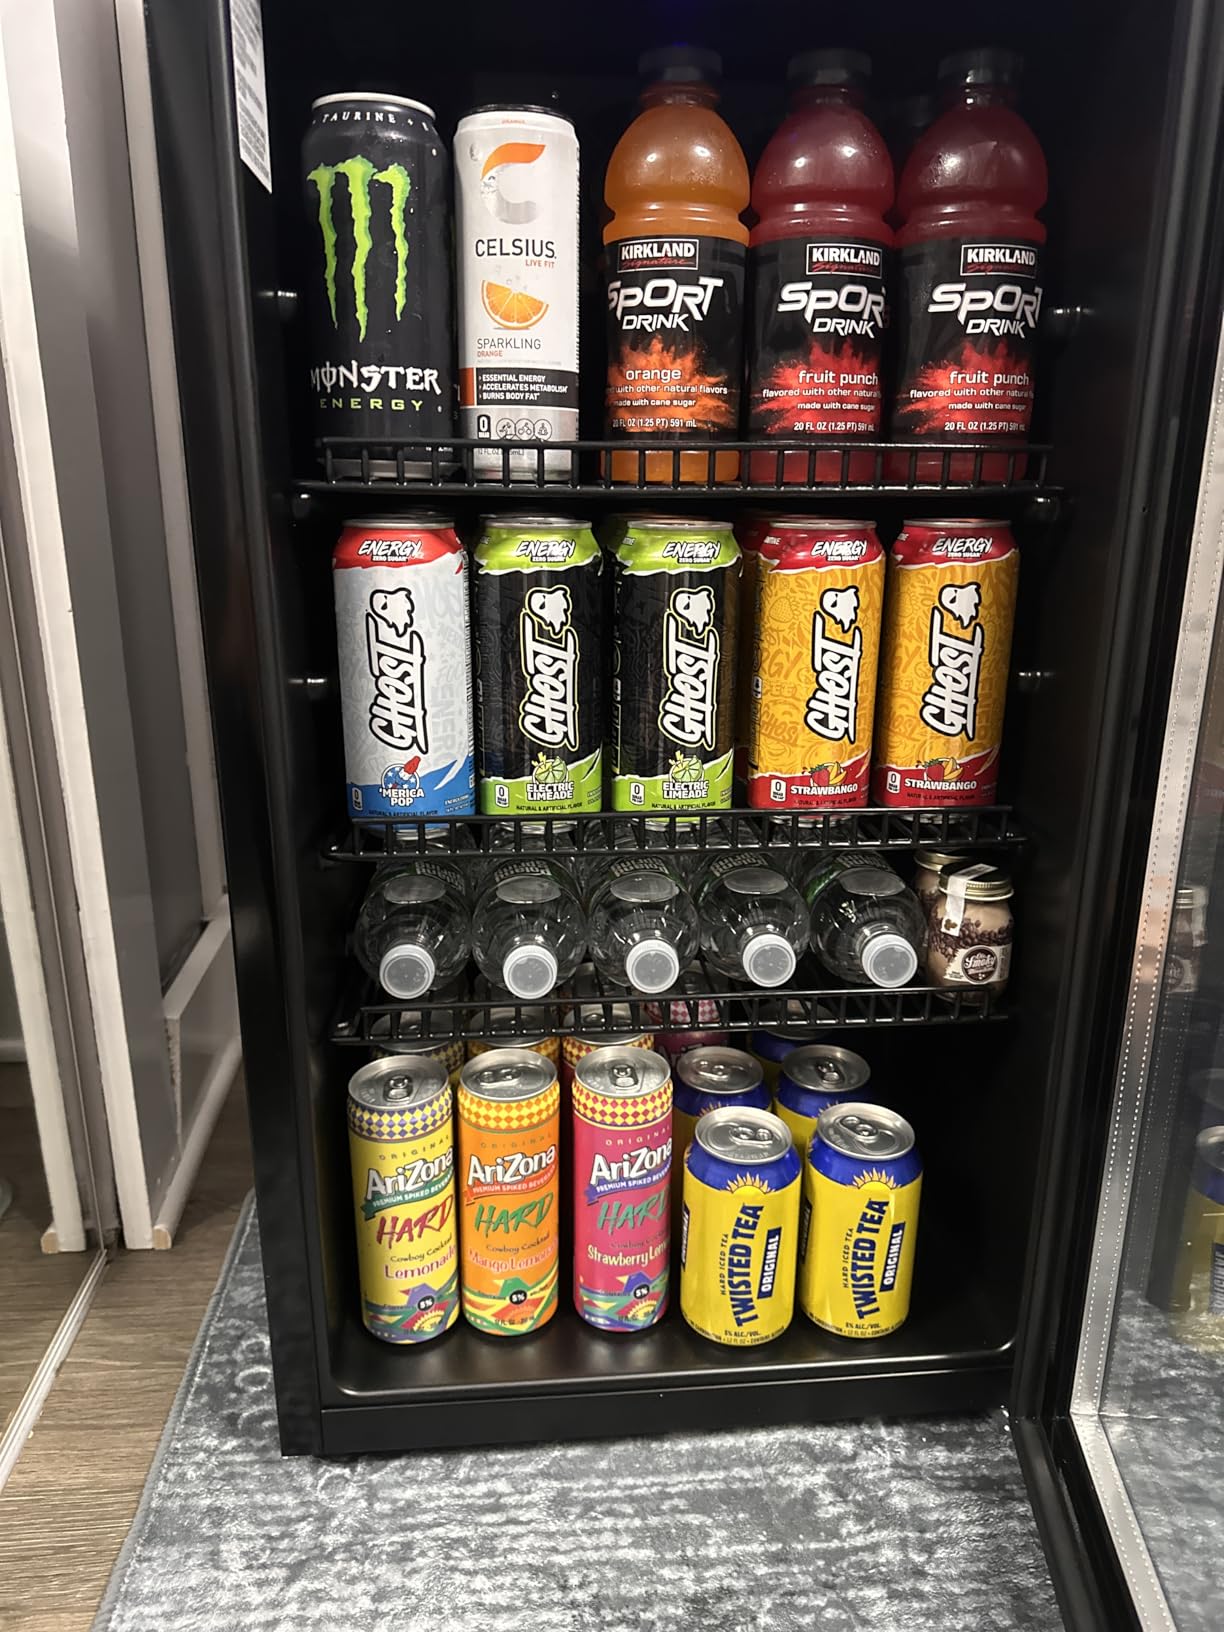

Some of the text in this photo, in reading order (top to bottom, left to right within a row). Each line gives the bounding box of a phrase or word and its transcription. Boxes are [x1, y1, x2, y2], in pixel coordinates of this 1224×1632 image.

[322, 111, 396, 124] TAURINE
[621, 242, 695, 260] KIRKLAND
[812, 247, 880, 266] KIRKLAND
[967, 248, 1035, 266] KIRKLAND
[525, 259, 555, 268] LIVE FIT
[777, 281, 887, 328] SPOR
[621, 313, 690, 332] DRINK
[812, 317, 875, 339] DRINK
[965, 318, 1026, 339] DRINK
[477, 338, 541, 349] SPARKLING
[311, 360, 441, 395] MONSTER
[482, 374, 546, 383] ESSENTIAL ENERGY
[625, 369, 682, 382] orange
[799, 370, 879, 387] fruit punch
[949, 370, 1029, 387] fruit punch
[482, 383, 529, 391] ACCELERATES
[616, 385, 634, 393] with
[636, 385, 661, 393] other
[663, 384, 697, 393] natural
[700, 385, 728, 395] flavors
[762, 387, 851, 398] flavored with other
[909, 389, 950, 399] flavored
[953, 387, 977, 396] with
[979, 388, 1004, 396] other
[319, 398, 423, 412] ENERGY
[797, 402, 821, 410] made
[823, 402, 841, 410] with
[948, 402, 972, 410] made
[974, 402, 993, 410] with
[627, 418, 636, 427] OZ
[637, 418, 654, 428] (1.25
[655, 418, 668, 428] PT)
[670, 418, 684, 427] 591
[685, 418, 697, 427] mL
[793, 421, 804, 431] 20
[805, 421, 815, 431] FL
[817, 421, 827, 431] OZ
[828, 421, 846, 432] (1.25
[847, 422, 857, 432] PT)
[944, 421, 1008, 432] 20 FL OZ (1.25 PT)
[358, 539, 424, 557] ENERGY
[514, 540, 576, 558] ENERGY
[662, 541, 721, 559] ENERGY
[811, 540, 867, 557] ENERGY
[931, 537, 993, 553] ENERGY
[519, 609, 579, 751] GHOST
[658, 609, 720, 751] GHOST
[804, 611, 862, 744] GHOST
[919, 605, 984, 741] GHOST
[366, 609, 428, 754] GHOST
[526, 782, 574, 792] ELECTRIC
[663, 781, 709, 791] ELECTRIC
[790, 783, 858, 795] STRAWBANGO
[904, 778, 977, 791] STRAWBANGO
[390, 798, 414, 806] POP
[527, 791, 573, 801] LIMEADE
[663, 790, 708, 799] LIMEADE
[466, 1144, 556, 1187] AriZona
[589, 1137, 672, 1186] AriZona
[365, 1146, 453, 1201] AriZona
[501, 1183, 528, 1192] SPIKED
[596, 1177, 651, 1193] PREMIUM SPIKED
[404, 1189, 430, 1201] SPIKED
[376, 1194, 454, 1250] HARD
[474, 1191, 554, 1239] HARD
[720, 1233, 729, 1248] TEA
[844, 1227, 854, 1242] TEA
[390, 1253, 425, 1262] Cowboy
[587, 1244, 649, 1268] Strawberry
[842, 1244, 851, 1262] ICED
[850, 1197, 889, 1319] TWISTED TEA
[882, 1229, 903, 1286] ORIGINAL
[727, 1202, 765, 1327] TWISTED TEA
[761, 1234, 779, 1293] ORIGINAL
[511, 1293, 525, 1303] 5%
[635, 1287, 649, 1298] 5%
[418, 1298, 433, 1310] 5%
